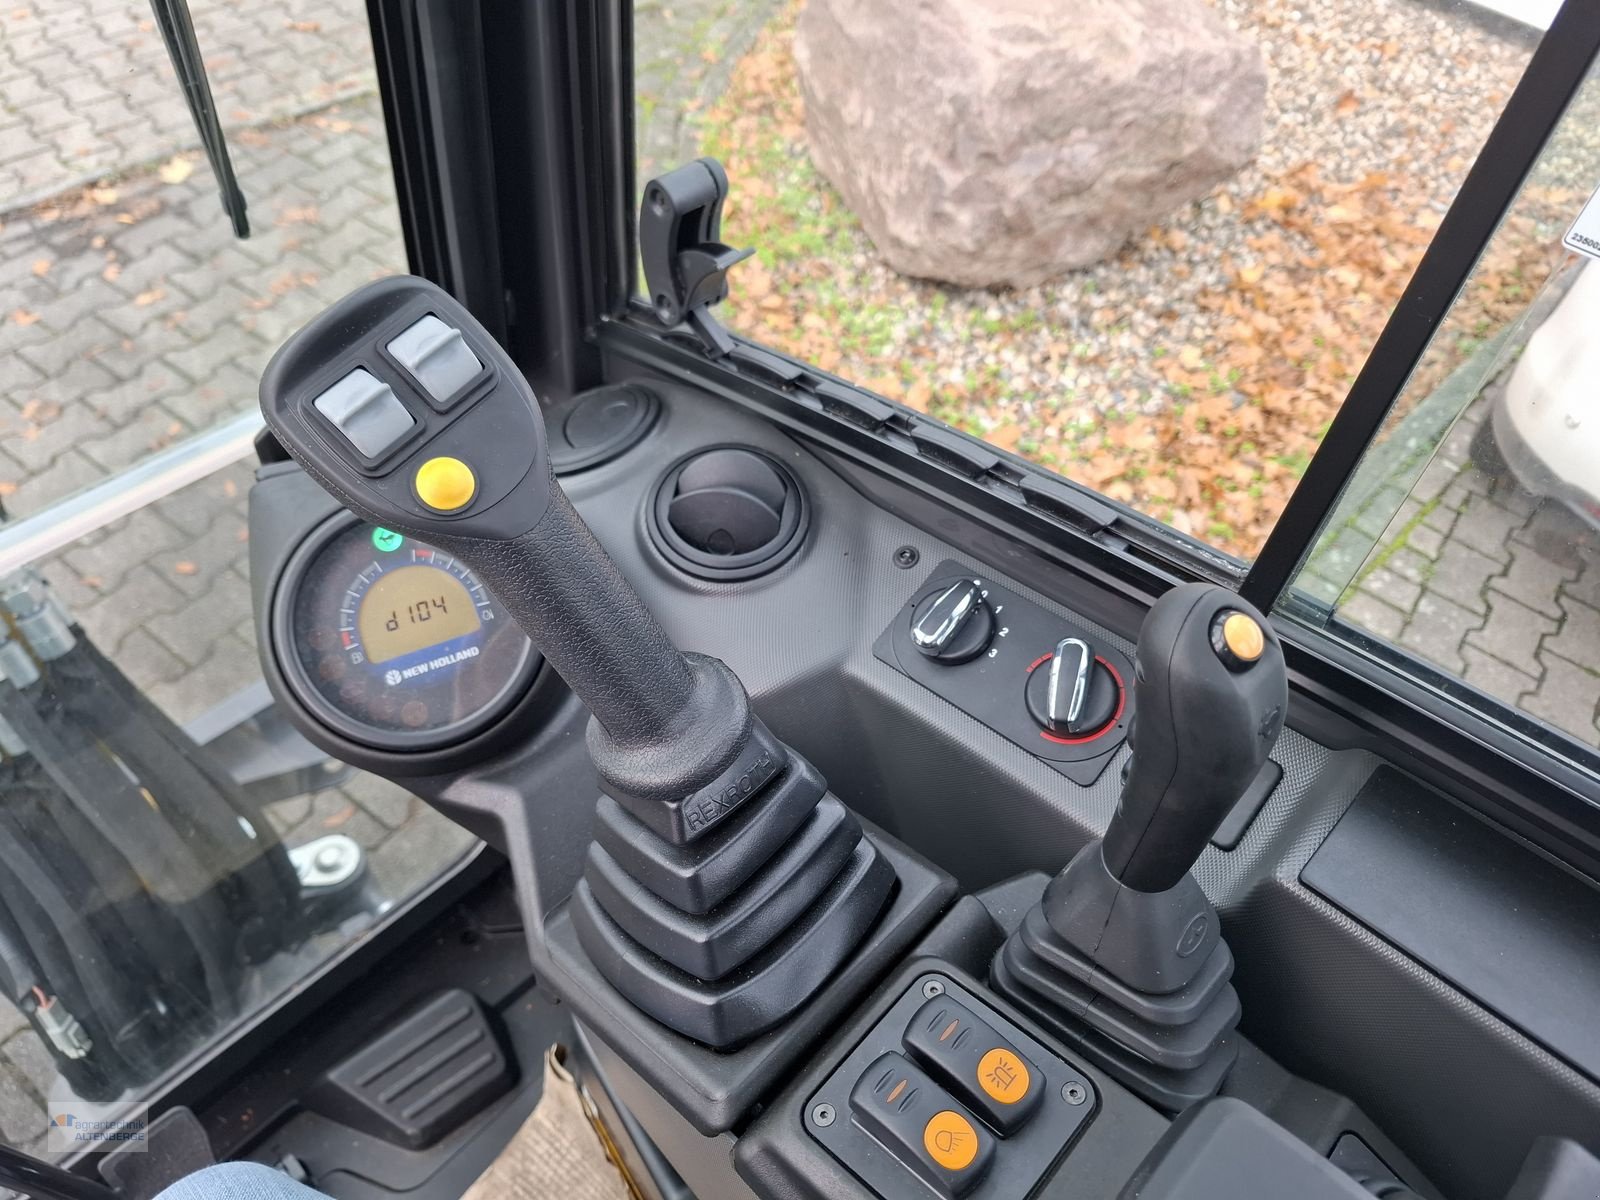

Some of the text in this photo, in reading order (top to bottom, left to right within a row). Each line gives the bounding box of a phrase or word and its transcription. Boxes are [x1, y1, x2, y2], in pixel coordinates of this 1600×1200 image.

[995, 605, 1003, 614] 1
[998, 627, 1009, 637] 2
[988, 648, 998, 658] 3
[402, 646, 480, 679] NEW HOLLAND
